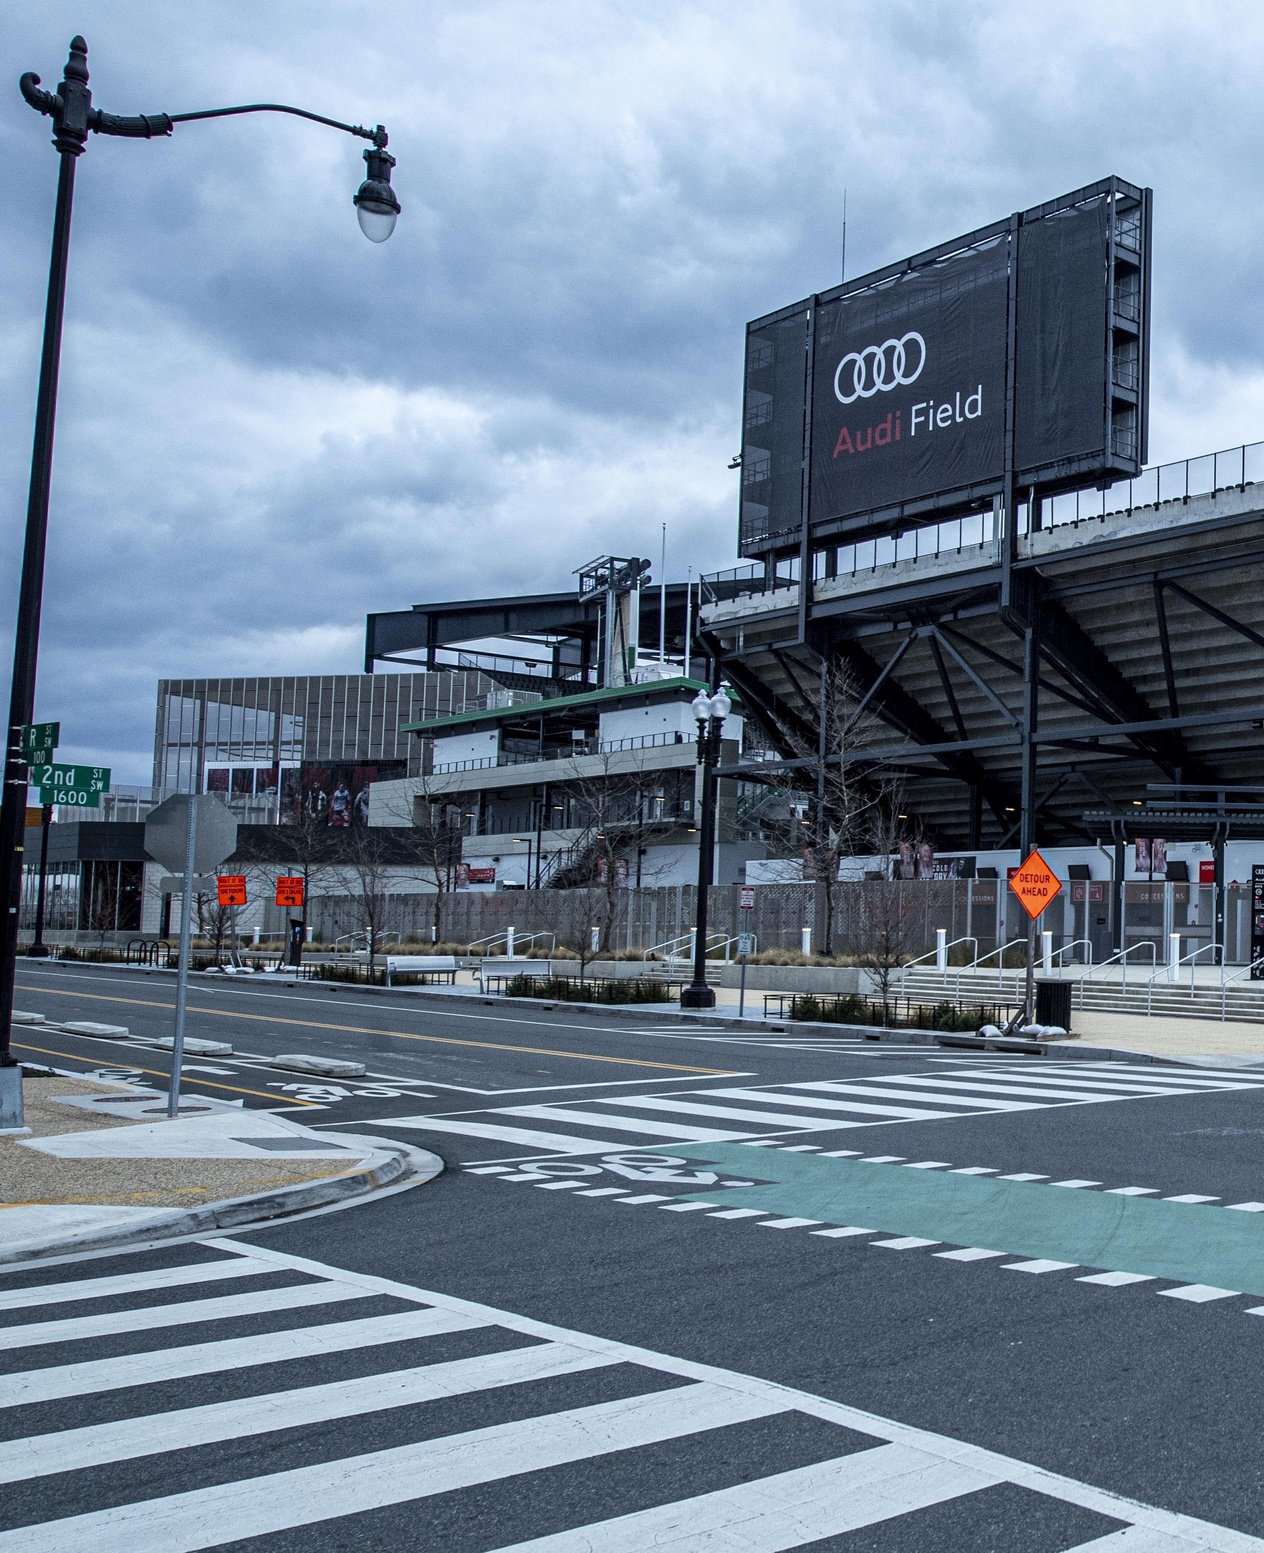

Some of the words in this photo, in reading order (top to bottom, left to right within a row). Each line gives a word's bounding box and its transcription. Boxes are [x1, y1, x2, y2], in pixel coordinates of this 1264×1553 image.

[832, 410, 901, 460] Audi
[910, 384, 983, 436] Field
[29, 728, 36, 747] R
[45, 725, 52, 735] ST
[44, 737, 52, 747] SW
[33, 750, 45, 763] 100
[41, 765, 75, 786] 2nd
[92, 768, 103, 778] ST
[91, 780, 103, 790] SW
[53, 790, 87, 804] 1600
[1019, 873, 1051, 884] DETOUR
[1021, 887, 1048, 897] AHEAD
